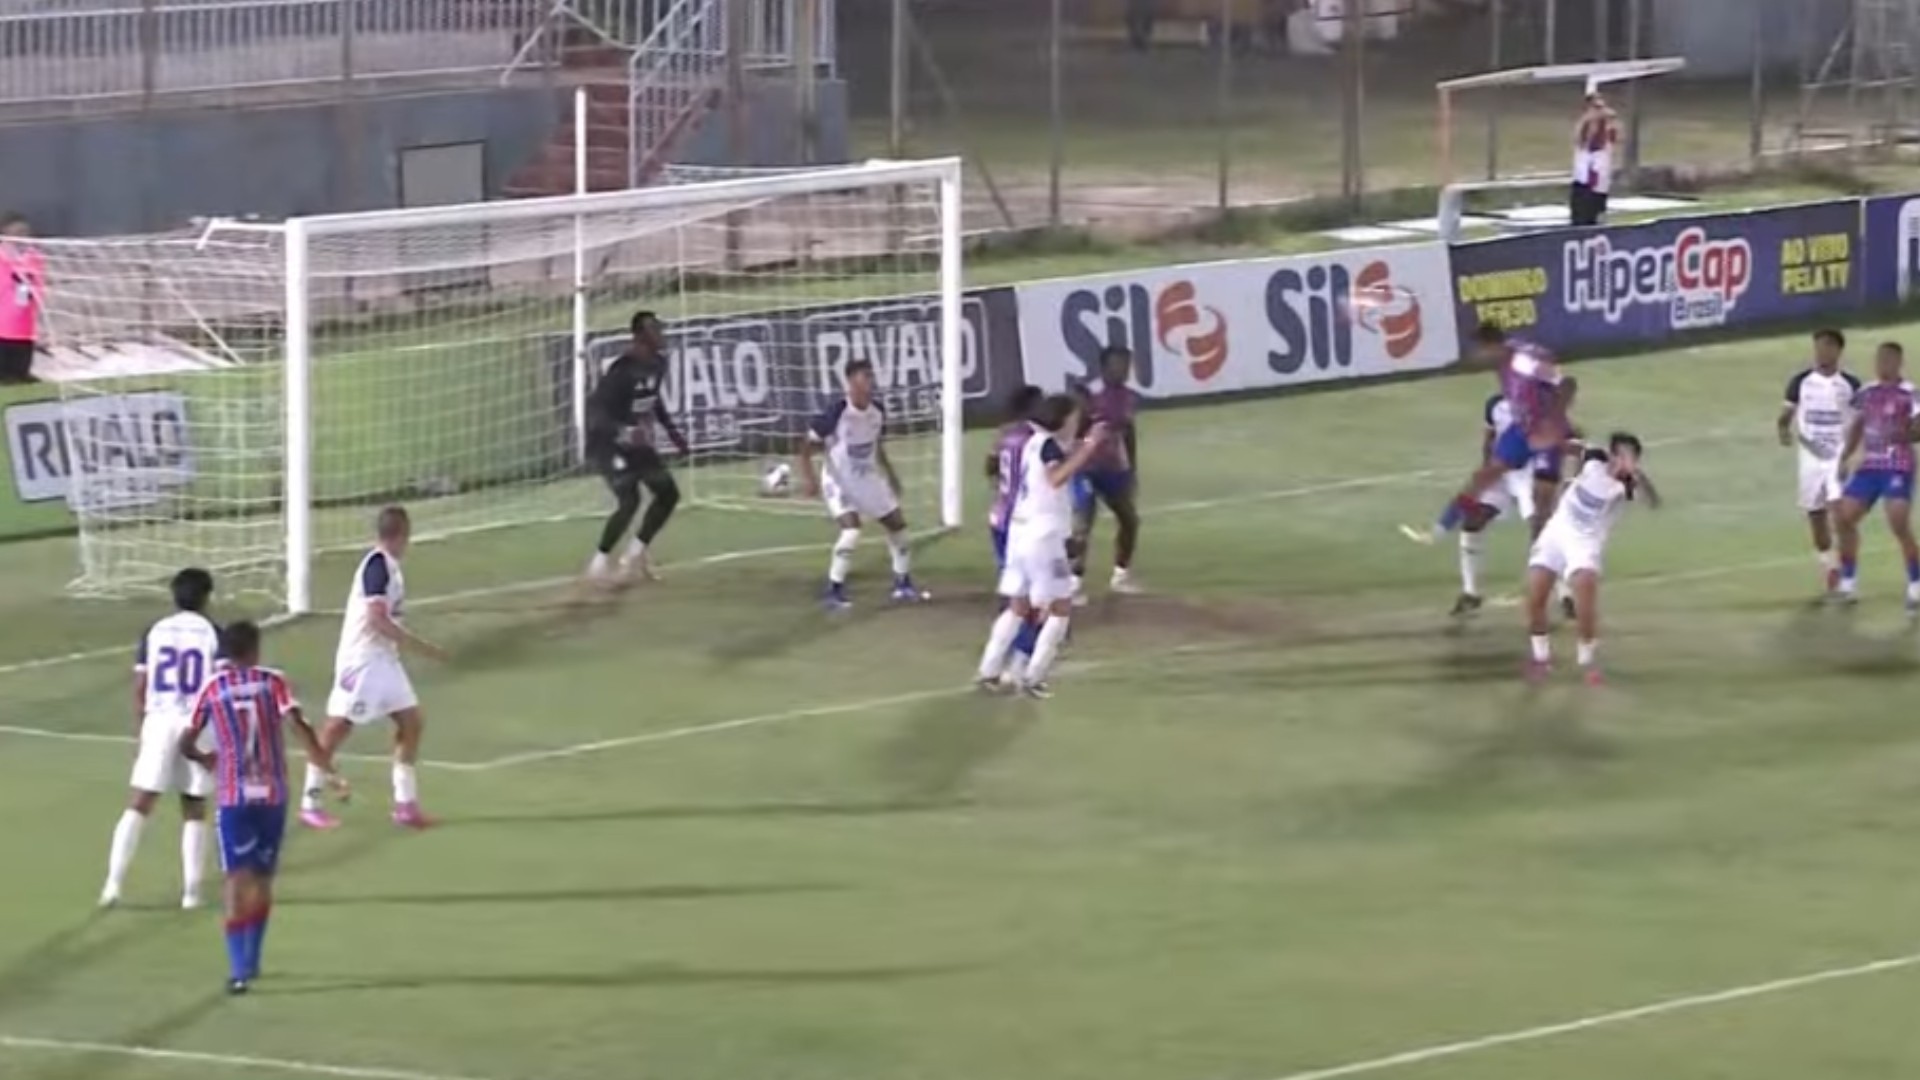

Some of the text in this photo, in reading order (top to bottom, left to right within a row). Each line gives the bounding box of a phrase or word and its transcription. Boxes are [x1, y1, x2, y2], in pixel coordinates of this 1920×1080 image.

[1564, 228, 1750, 320] HiperCap
[1782, 232, 1849, 265] AO VIVO
[1782, 261, 1850, 294] PELA TV
[602, 340, 769, 415] VALO
[18, 411, 184, 481] RIVALO
[154, 645, 204, 695] 20
[232, 701, 259, 756] 7
